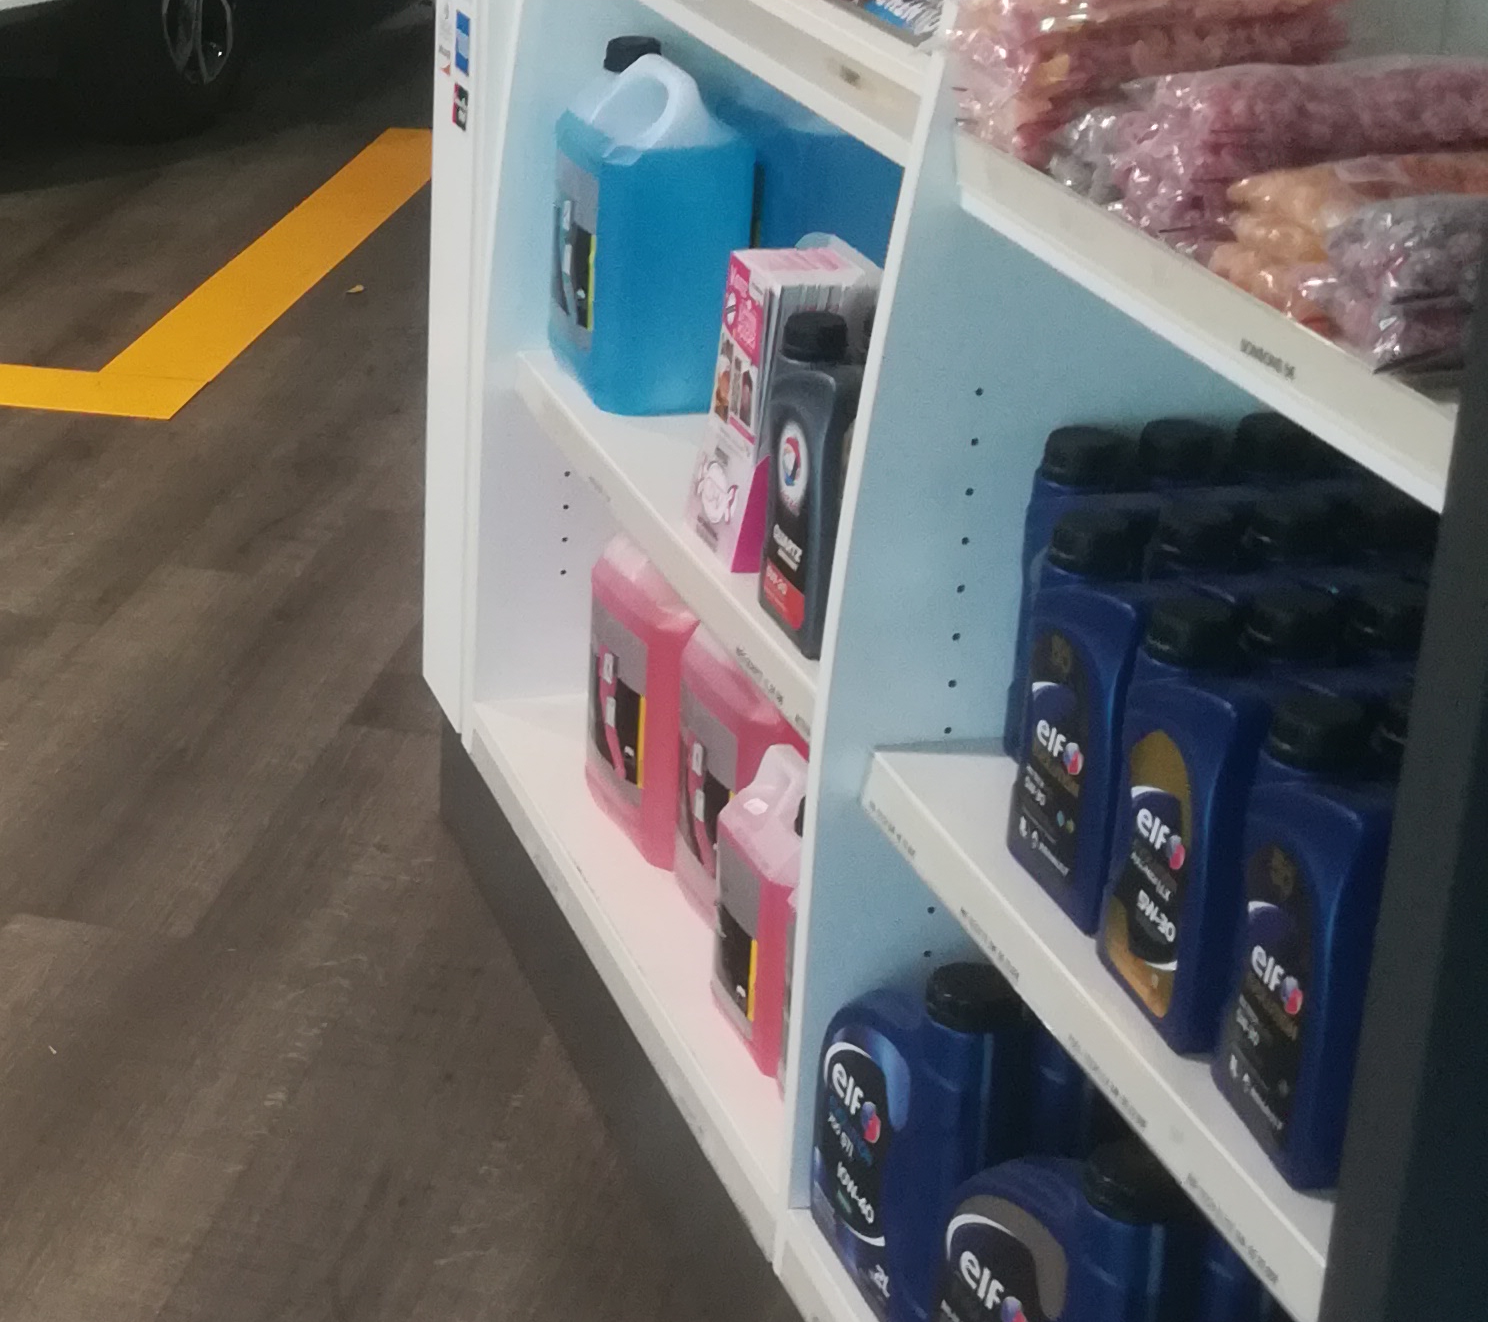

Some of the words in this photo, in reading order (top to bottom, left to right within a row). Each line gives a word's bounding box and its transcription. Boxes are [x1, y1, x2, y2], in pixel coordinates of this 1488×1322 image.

[1036, 718, 1067, 758] elf
[1136, 807, 1171, 851] elf
[1251, 944, 1285, 993] elf
[831, 1061, 865, 1116] elf
[959, 1249, 1006, 1311] elf
